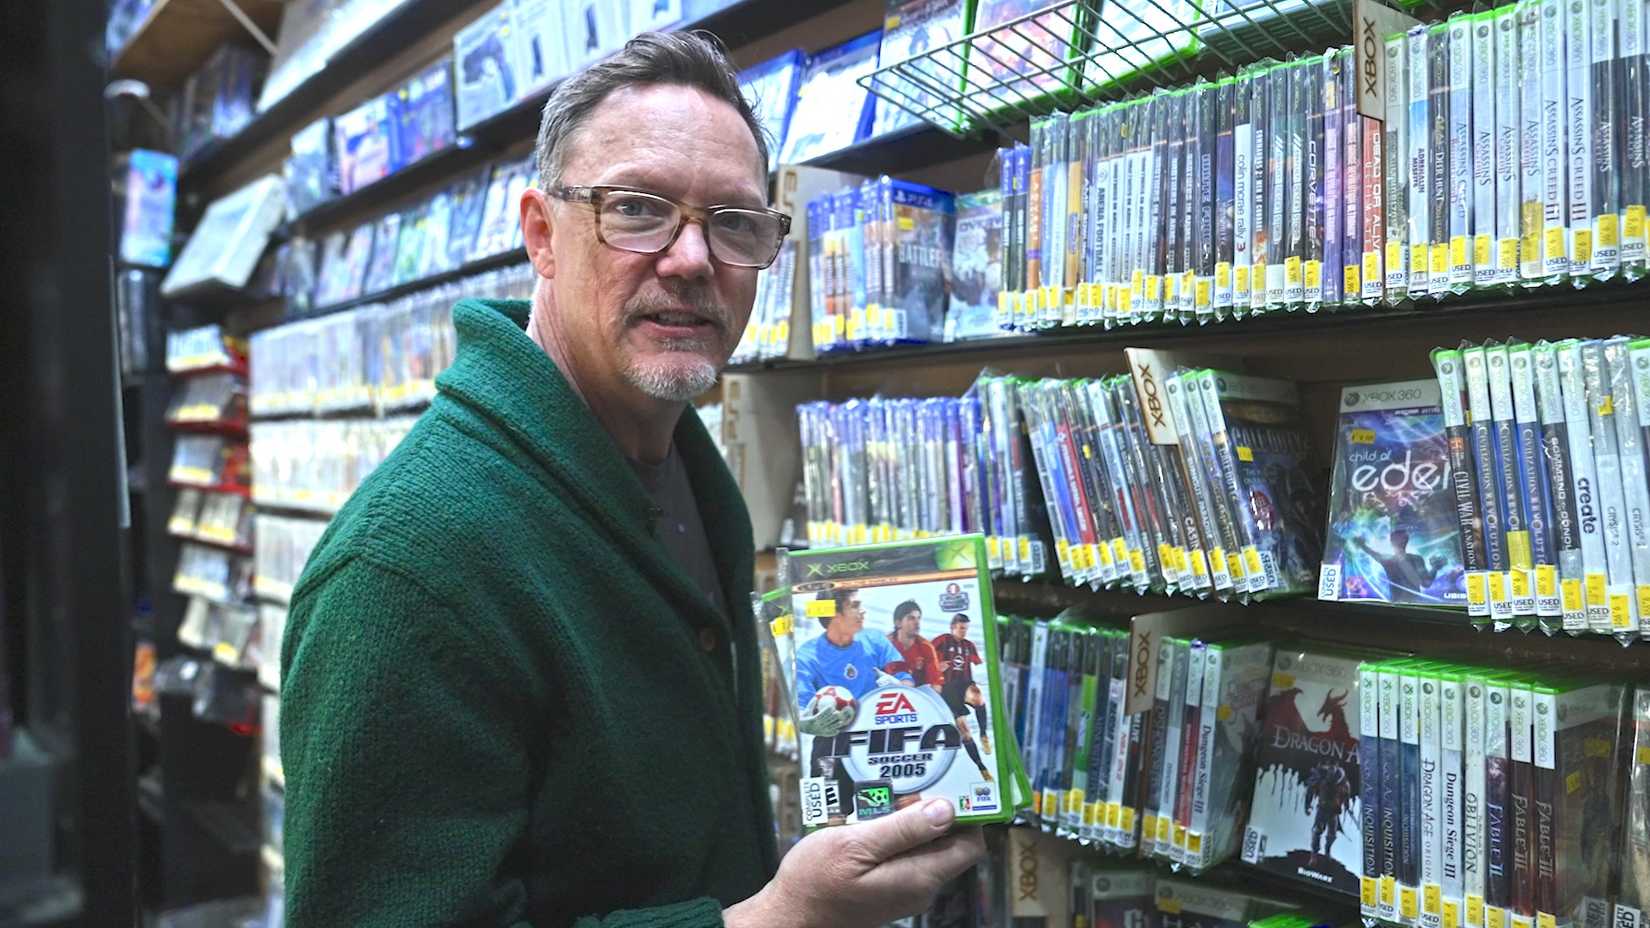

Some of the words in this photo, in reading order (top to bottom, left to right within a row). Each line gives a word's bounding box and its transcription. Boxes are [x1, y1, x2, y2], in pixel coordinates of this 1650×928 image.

[1363, 18, 1377, 96] XBOX
[1237, 154, 1247, 180] colin
[1546, 160, 1559, 202] CREED
[1573, 159, 1586, 202] CREED
[1237, 181, 1246, 215] mcrae
[1373, 184, 1380, 208] OR
[1572, 203, 1586, 221] III
[1234, 217, 1246, 239] rally
[1237, 242, 1245, 252] 3
[1545, 256, 1567, 266] USED
[1593, 248, 1616, 258] USED
[1452, 264, 1472, 272] USED
[1138, 363, 1166, 427] XBOX
[1400, 389, 1421, 399] 360
[1349, 450, 1376, 462] child
[1478, 426, 1493, 489] CIVILIZATION
[1501, 427, 1514, 489] CIVILIZATION
[1523, 429, 1537, 495] CIVILIZATION
[1551, 437, 1567, 500] COMMAND
[1453, 471, 1470, 501] CIVIL
[1457, 502, 1474, 525] WAR
[1577, 477, 1597, 535] create
[1485, 493, 1501, 569] REVOLUTION
[827, 561, 870, 573] XBOX
[1325, 568, 1336, 597] USED
[1541, 599, 1560, 607] USED
[1135, 631, 1150, 698] XBOX
[875, 693, 917, 715] EA
[875, 714, 917, 725] SPORTS
[832, 724, 961, 757] FIFA
[1272, 727, 1341, 758] DRAGON
[868, 753, 933, 765] SOCCER
[880, 762, 926, 779] 2005
[811, 783, 822, 818] USED
[1422, 758, 1435, 812] DRAGON
[1444, 772, 1457, 825] Dungeon
[1423, 813, 1435, 837] AGE
[1465, 792, 1477, 874] OBLIVION
[1486, 803, 1503, 855] FABLE
[1511, 793, 1527, 850] FABLE
[1536, 800, 1552, 855] FABLE
[1247, 828, 1259, 858] USED
[1365, 803, 1375, 876] INQUISITION
[1383, 807, 1393, 877] INQUISITION
[1444, 829, 1457, 861] Siege
[1019, 841, 1037, 901] XBOX
[1445, 863, 1457, 879] III
[1622, 911, 1634, 928] ED
